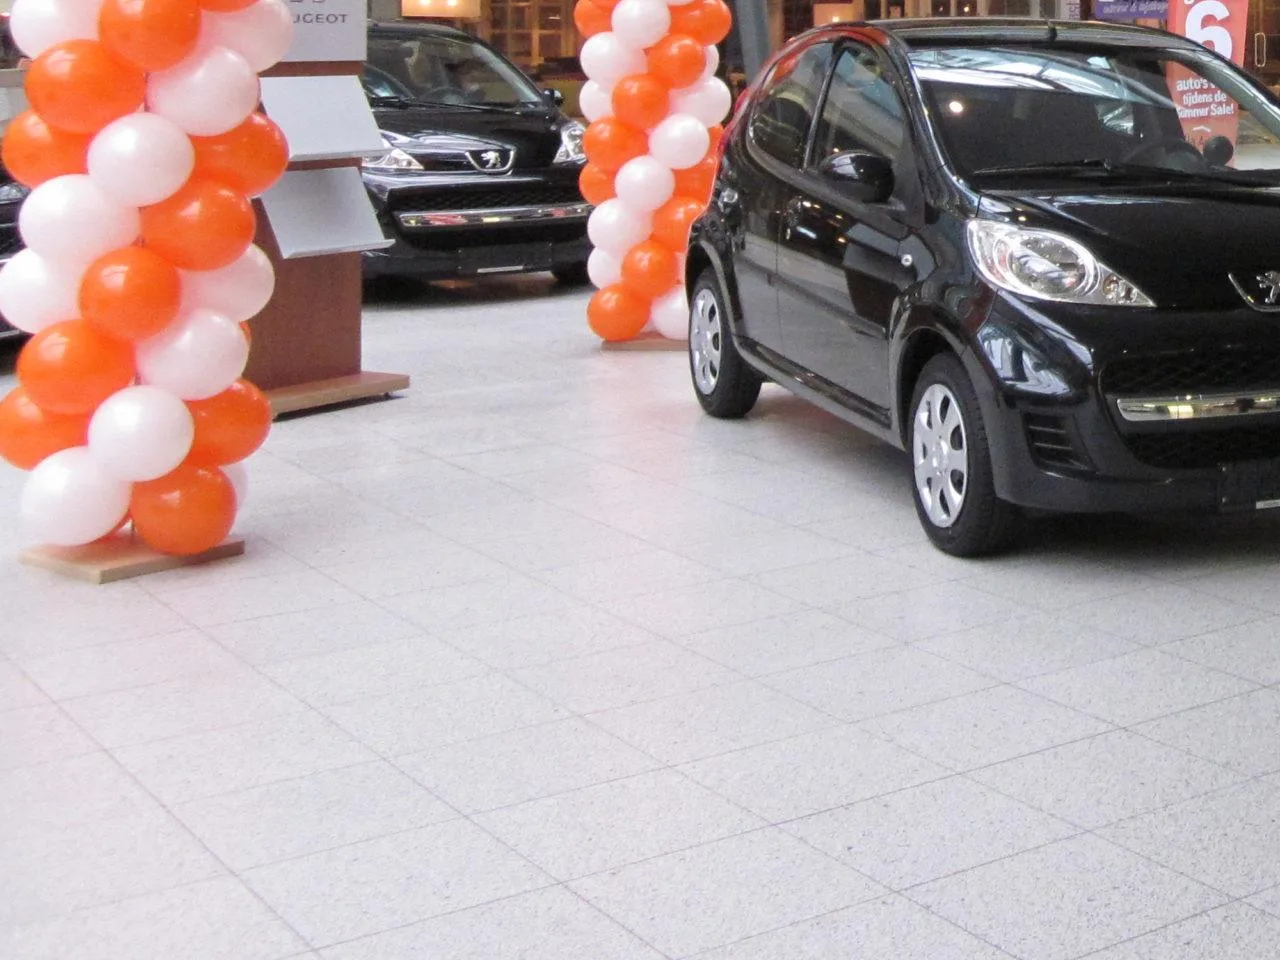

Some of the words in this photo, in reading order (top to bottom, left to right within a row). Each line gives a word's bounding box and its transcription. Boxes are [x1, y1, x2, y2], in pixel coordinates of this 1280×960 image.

[293, 13, 348, 24] UGEOT
[1185, 0, 1233, 60] 6
[1176, 77, 1208, 92] auto's
[1183, 91, 1213, 107] tijdens
[1214, 90, 1227, 102] de
[1211, 103, 1234, 116] Sale!
